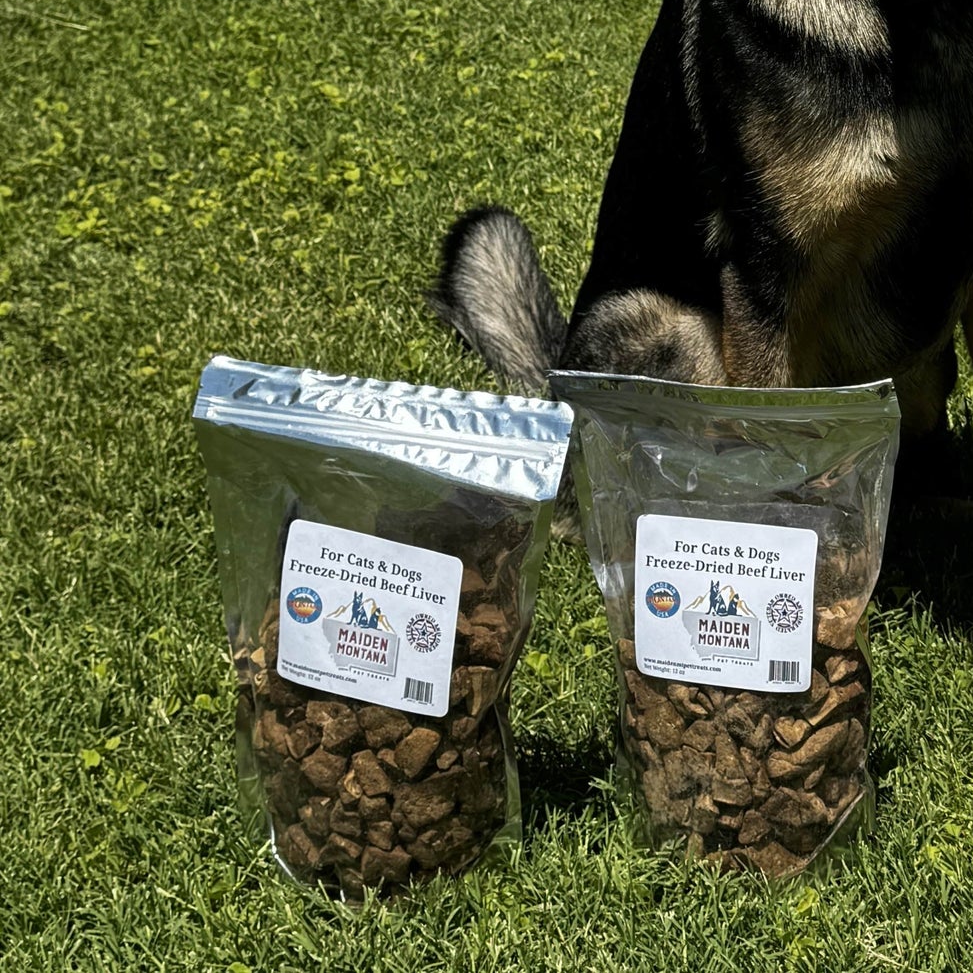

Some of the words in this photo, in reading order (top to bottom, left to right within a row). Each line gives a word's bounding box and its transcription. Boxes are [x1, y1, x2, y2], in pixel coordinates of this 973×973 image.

[674, 541, 697, 554] For
[702, 543, 730, 556] Cats
[734, 546, 744, 558] &
[748, 547, 780, 563] Dogs
[320, 547, 344, 562] For
[348, 553, 374, 569] Cats
[378, 561, 387, 572] &
[391, 563, 422, 582] Dogs
[646, 555, 733, 574] Freeze-Dried
[738, 564, 768, 578] Beef
[770, 568, 806, 581] Liver
[289, 559, 377, 588] Freeze-Dried
[380, 580, 409, 595] Beef
[412, 587, 446, 605] Liver
[699, 619, 750, 636] MAIDEN
[338, 628, 388, 651] MAIDEN
[698, 633, 750, 650] MONTANA
[337, 642, 386, 665] MONTANA
